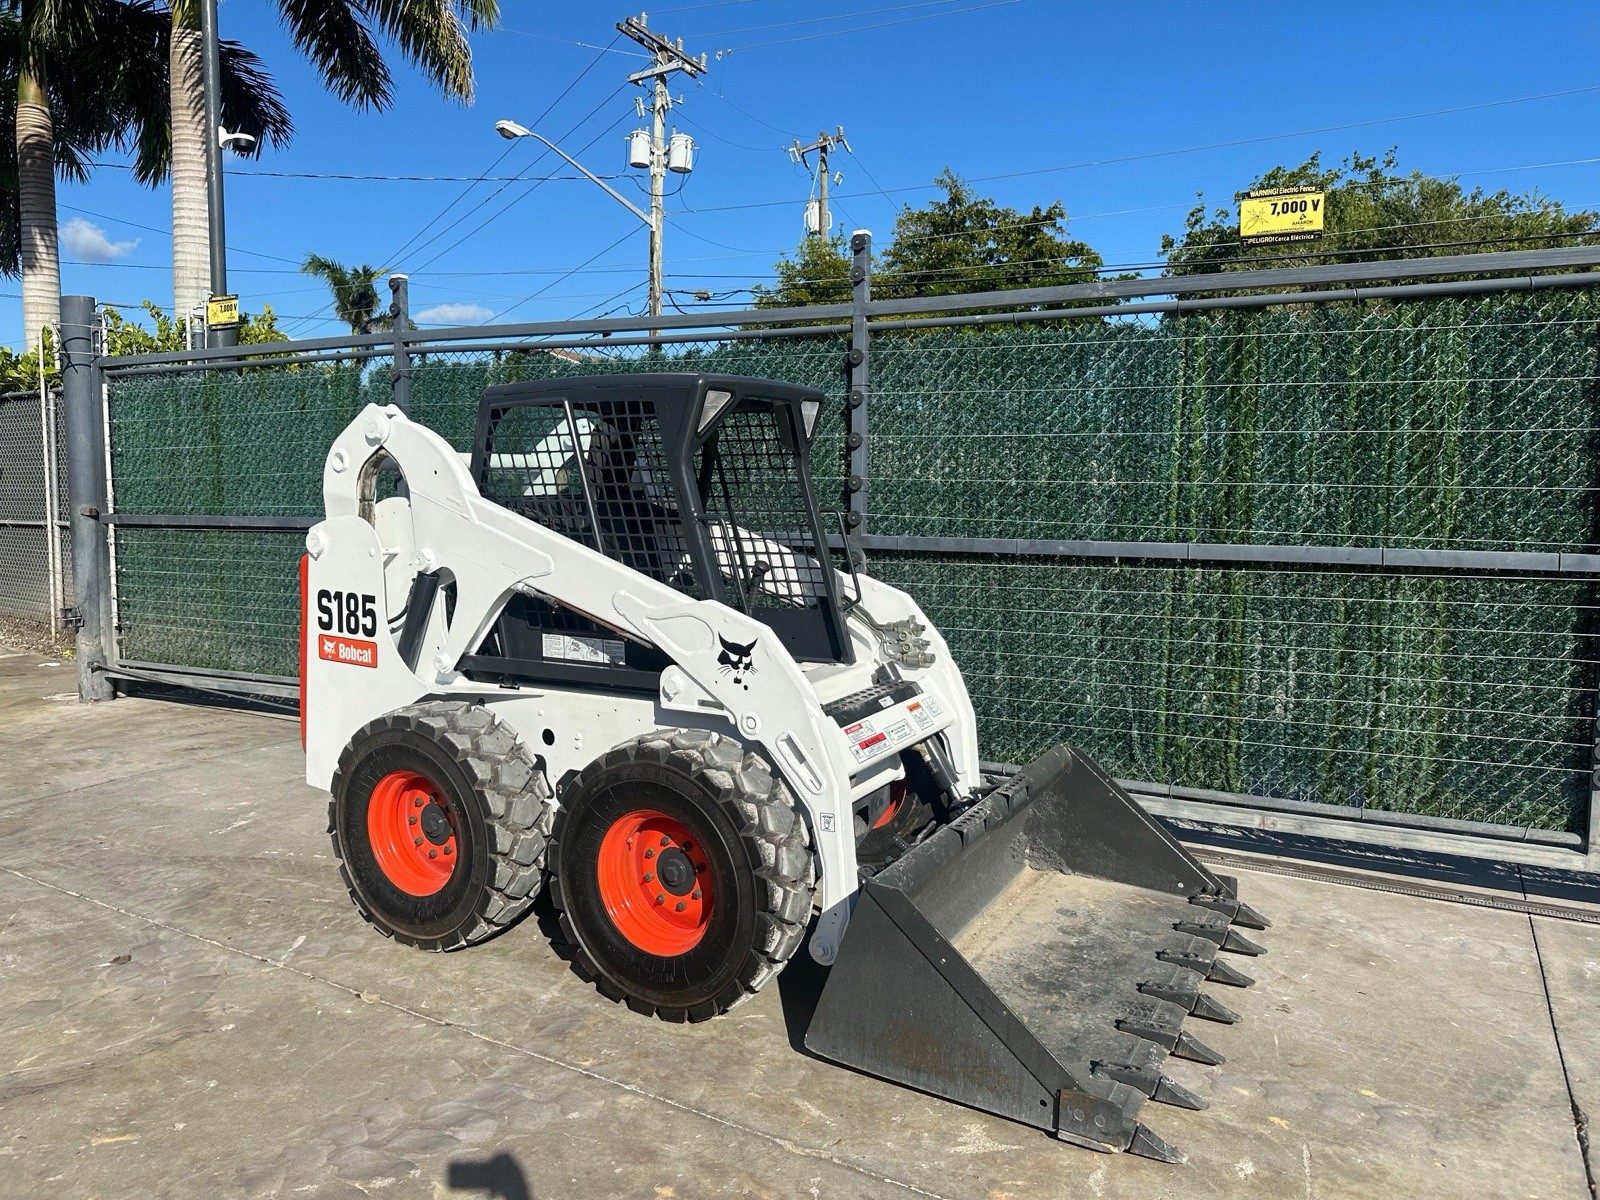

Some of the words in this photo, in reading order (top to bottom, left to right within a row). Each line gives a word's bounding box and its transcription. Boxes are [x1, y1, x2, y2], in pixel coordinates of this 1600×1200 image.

[1250, 188, 1278, 198] WARNING!
[1280, 186, 1299, 195] Electric
[1300, 185, 1315, 193] Fence
[1270, 200, 1307, 216] 7,000
[1312, 199, 1320, 211] V
[1290, 233, 1314, 241] Eléctrica
[317, 589, 377, 638] S185
[338, 643, 372, 663] Bobcat
